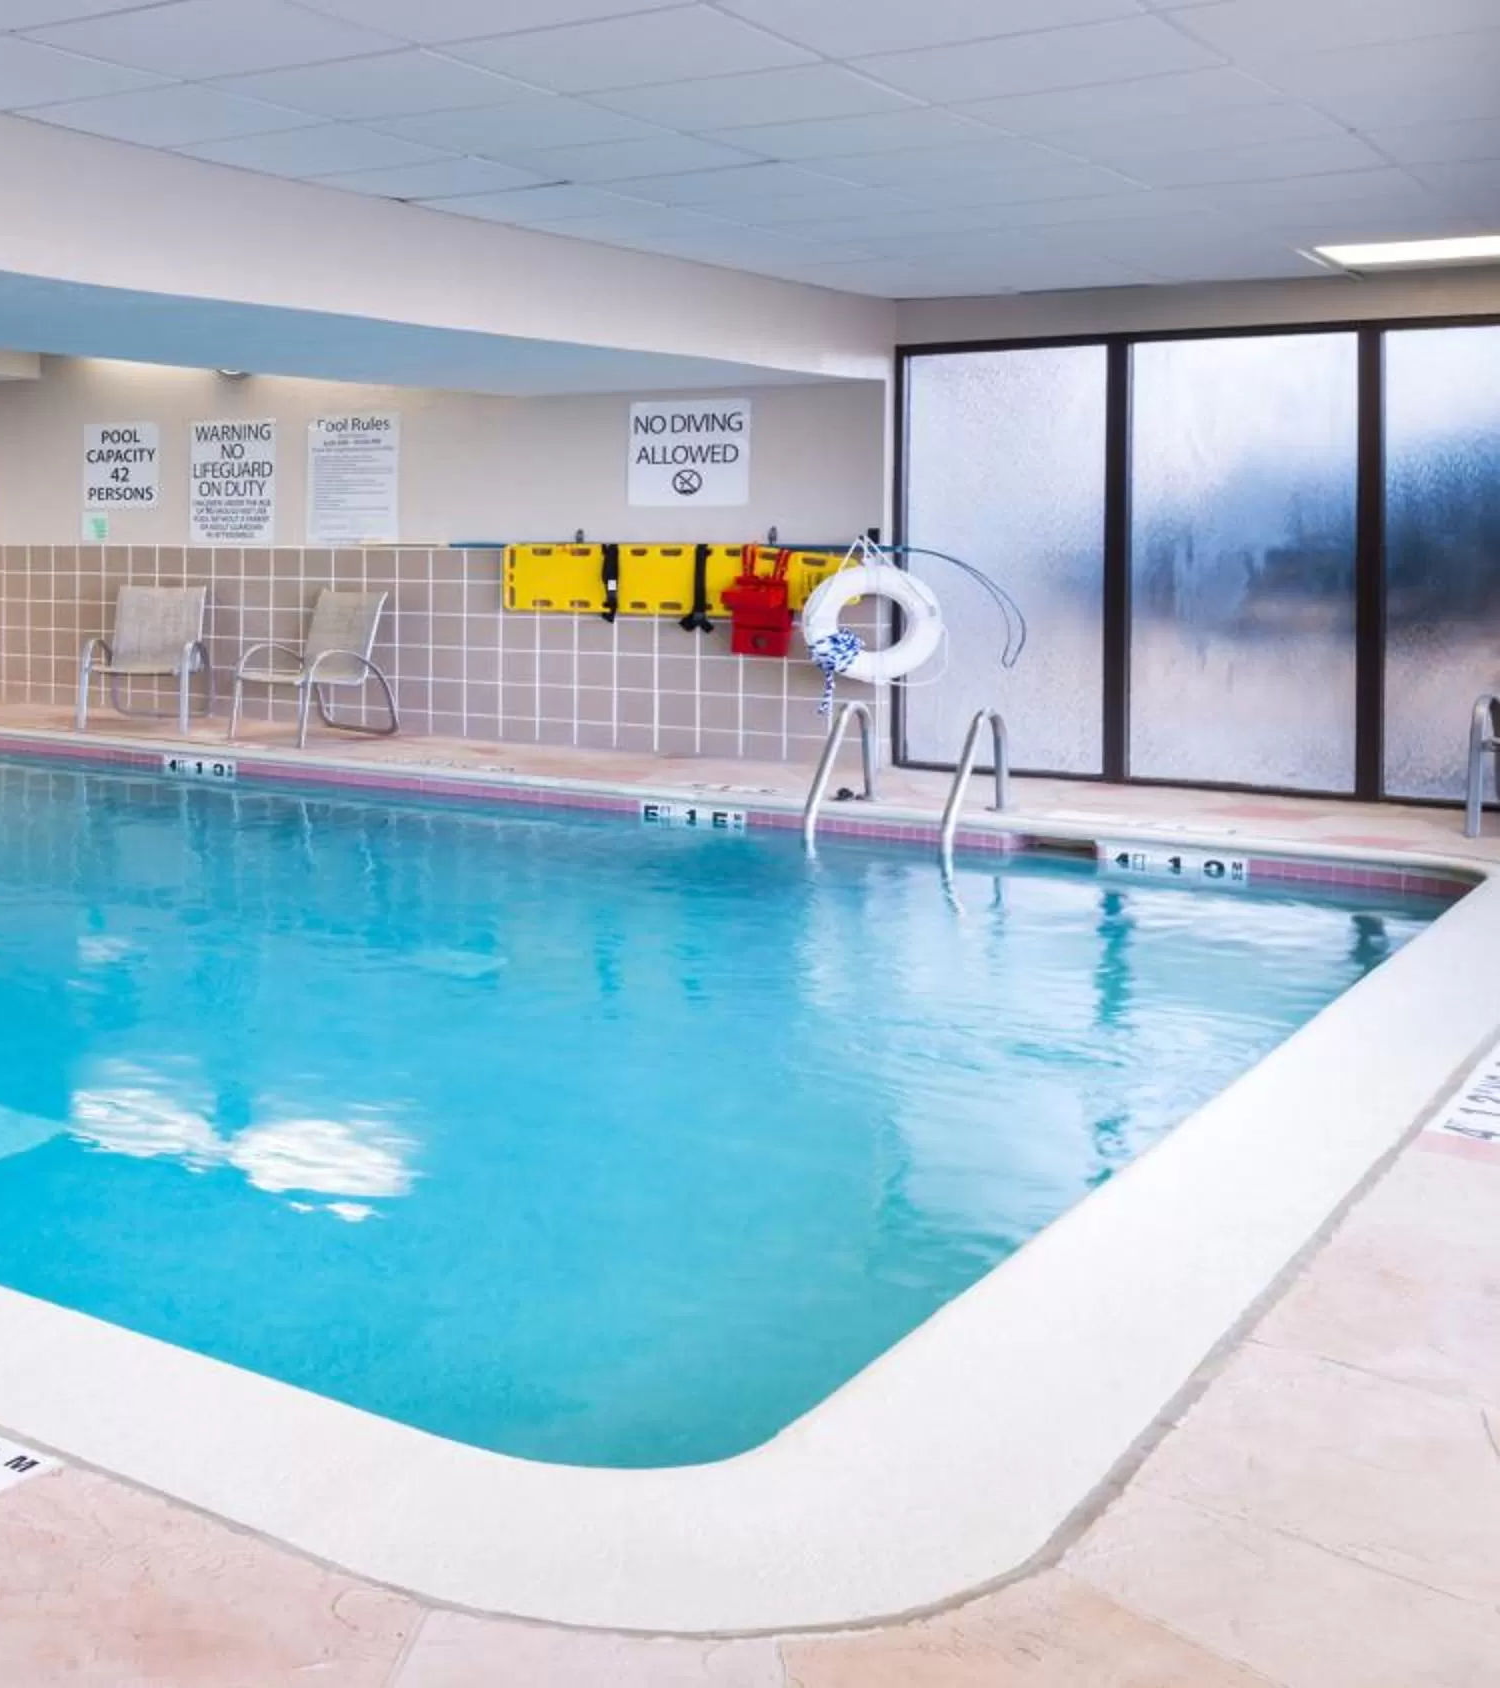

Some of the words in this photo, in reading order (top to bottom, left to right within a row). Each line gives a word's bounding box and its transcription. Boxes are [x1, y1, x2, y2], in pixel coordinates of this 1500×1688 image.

[351, 417, 390, 431] Rules
[634, 414, 667, 434] NO
[671, 412, 743, 433] DIVING
[101, 428, 141, 444] POOL
[195, 423, 272, 442] WARNING
[86, 448, 156, 463] CAPACITY
[221, 443, 245, 460] NO
[635, 444, 739, 465] ALLOWED
[110, 467, 130, 482] 42
[193, 461, 273, 479] LIFEGUARD
[87, 486, 154, 501] PERSONS
[198, 480, 221, 497] ON
[225, 480, 266, 496] DUTY
